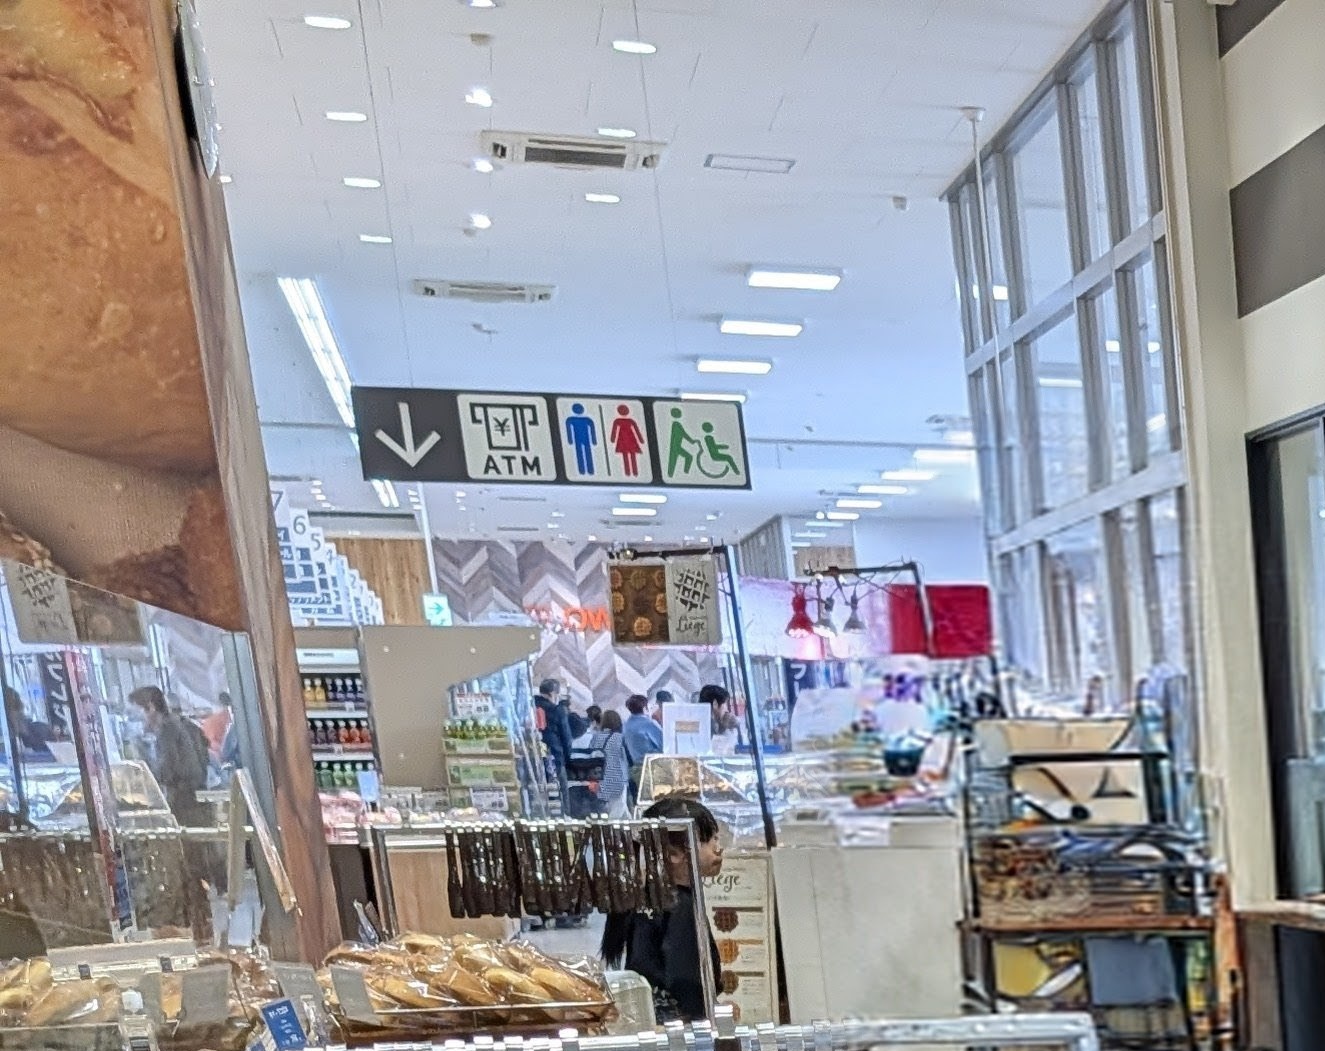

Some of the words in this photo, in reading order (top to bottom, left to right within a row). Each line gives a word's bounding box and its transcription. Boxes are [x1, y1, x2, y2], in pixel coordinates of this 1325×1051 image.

[483, 455, 542, 476] ATM
[292, 515, 307, 535] 6
[311, 533, 321, 551] 5
